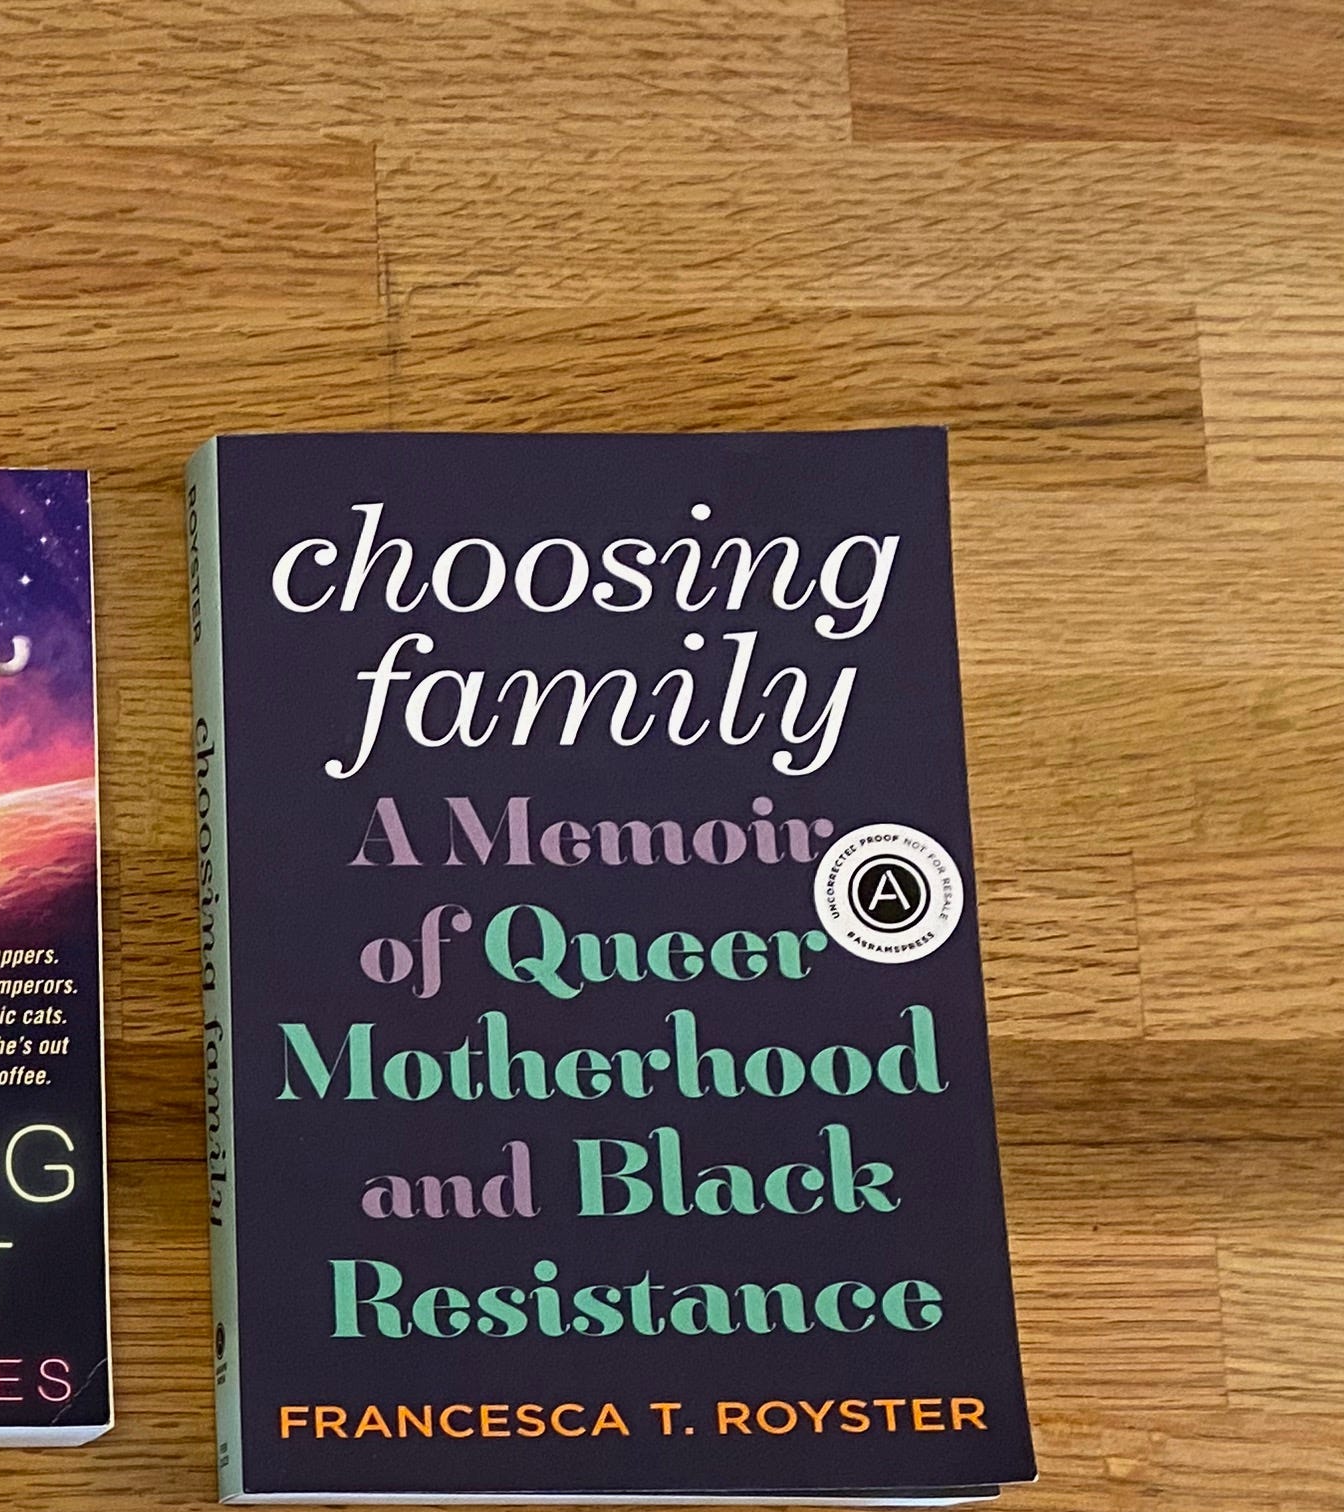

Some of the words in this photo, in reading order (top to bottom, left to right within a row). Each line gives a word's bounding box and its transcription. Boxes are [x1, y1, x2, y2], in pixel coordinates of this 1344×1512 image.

[188, 484, 202, 646] ROYSTER
[272, 503, 900, 641] choosing
[325, 631, 857, 778] family
[348, 797, 423, 866] A
[443, 797, 835, 866] Memoir
[827, 845, 856, 920] UNCORRECTED
[860, 834, 899, 846] PROOF
[903, 838, 926, 853] NOT
[928, 853, 945, 874] FOR
[939, 877, 952, 920] RESALE
[360, 903, 473, 998] of
[485, 903, 829, 999] Queer
[847, 932, 934, 953] #ABRAMSPRESS
[23, 1007, 68, 1026] cats.
[38, 1038, 69, 1056] out
[276, 1005, 950, 1102] Motherhood
[362, 1140, 541, 1219] and
[577, 1124, 902, 1216] Black
[330, 1260, 945, 1339] Resistance
[279, 1403, 629, 1440] FRANCESCA
[651, 1402, 693, 1435] T.
[717, 1396, 988, 1434] ROYSTER
